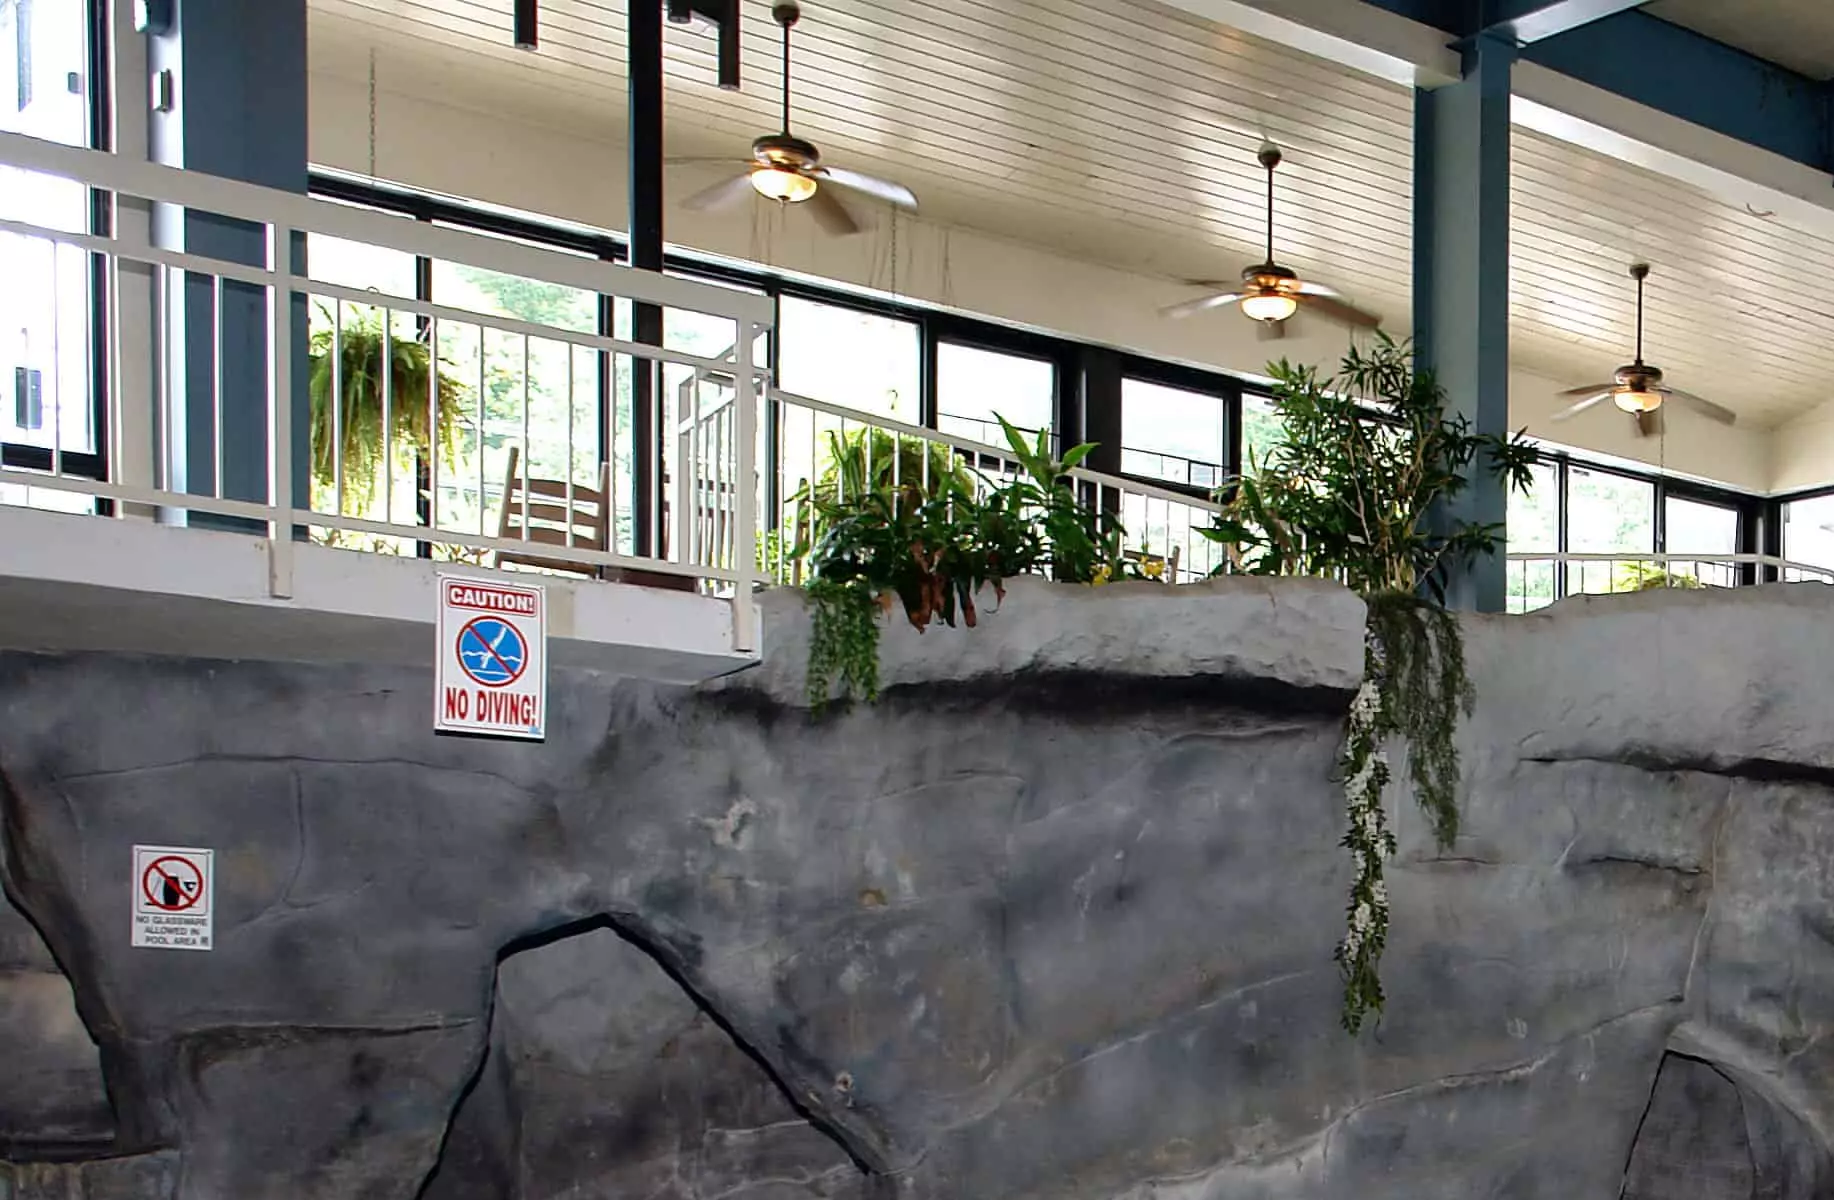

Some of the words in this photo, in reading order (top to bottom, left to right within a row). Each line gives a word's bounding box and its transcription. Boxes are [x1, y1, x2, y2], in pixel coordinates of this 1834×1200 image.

[450, 587, 534, 611] CAUTION!
[446, 687, 468, 719] NO
[476, 690, 537, 726] DIVING!
[145, 936, 170, 944] POOL
